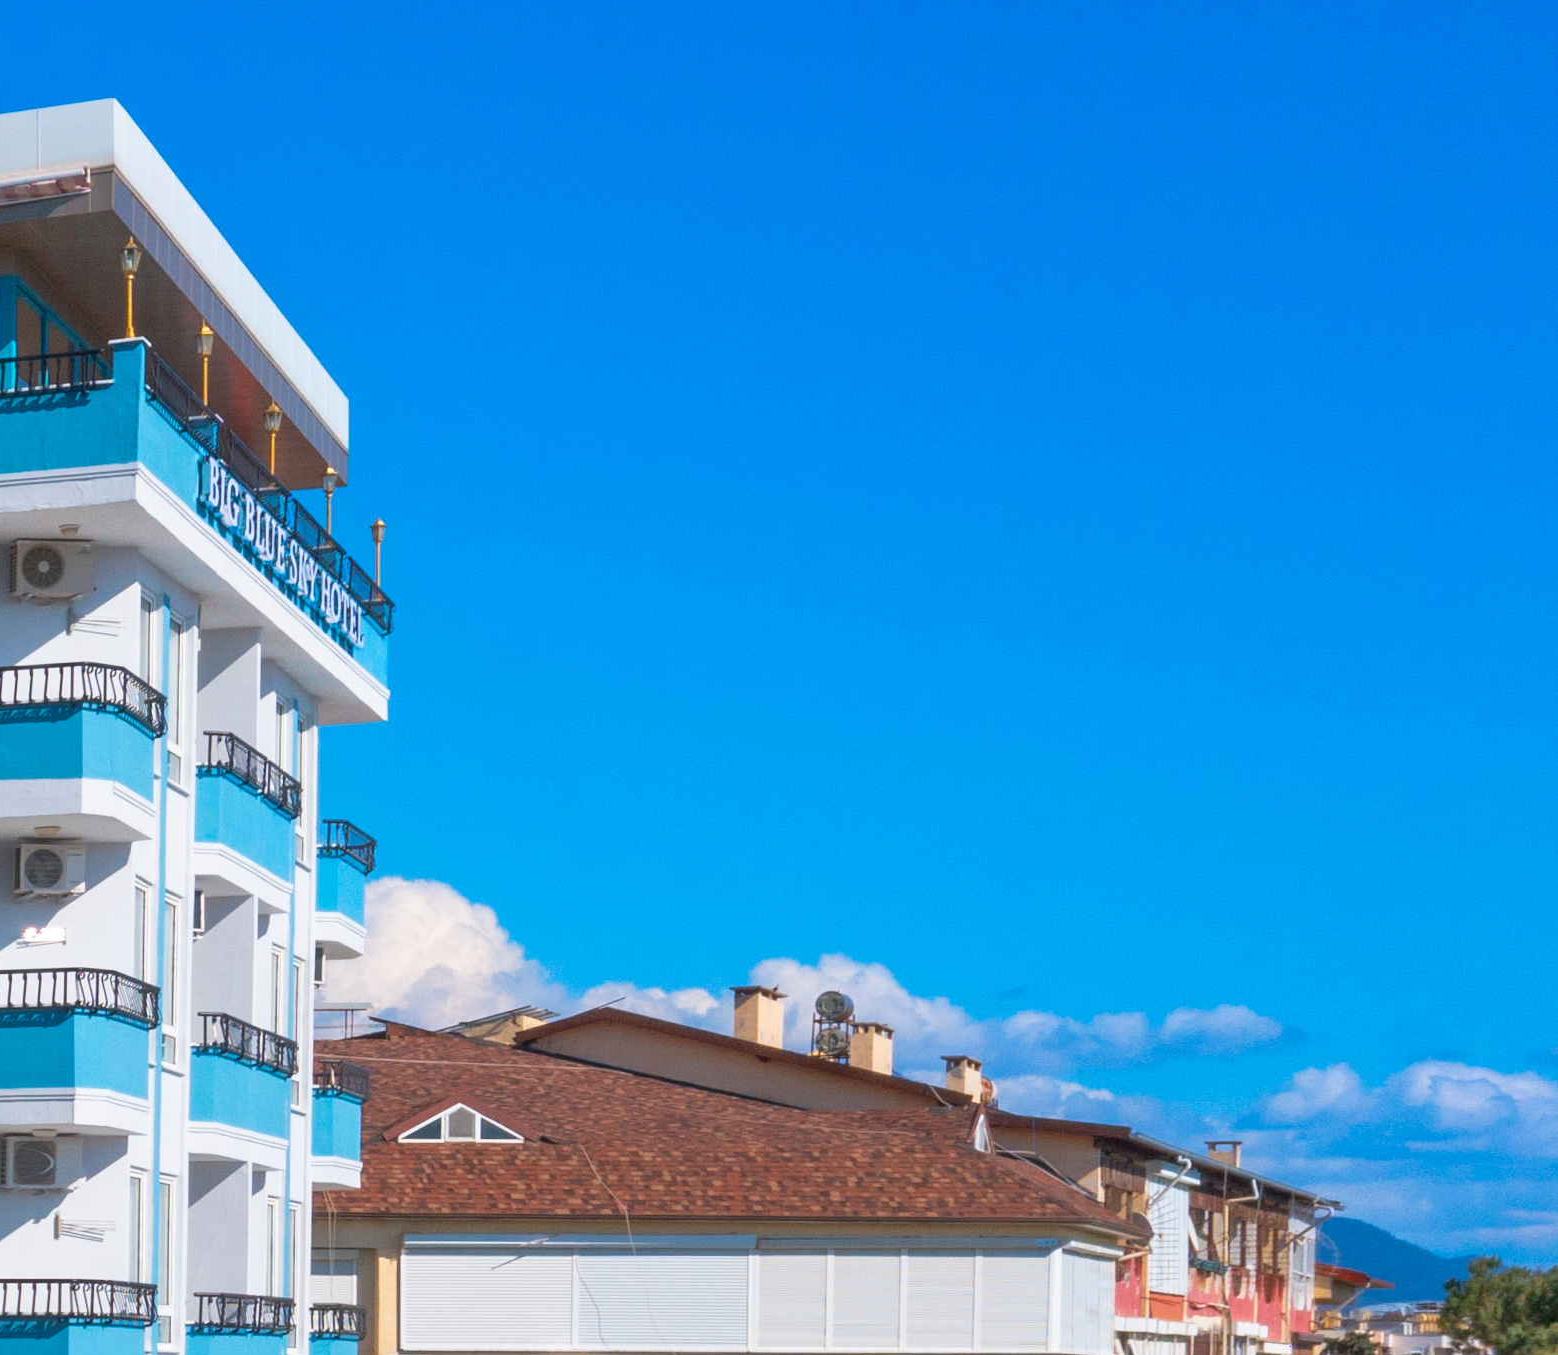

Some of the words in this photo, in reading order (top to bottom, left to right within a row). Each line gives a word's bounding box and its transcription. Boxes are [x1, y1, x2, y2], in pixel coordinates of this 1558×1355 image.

[208, 456, 240, 527] BIG
[244, 493, 287, 574] BLUE
[287, 538, 320, 602] SKY
[320, 569, 365, 649] HOTEL
